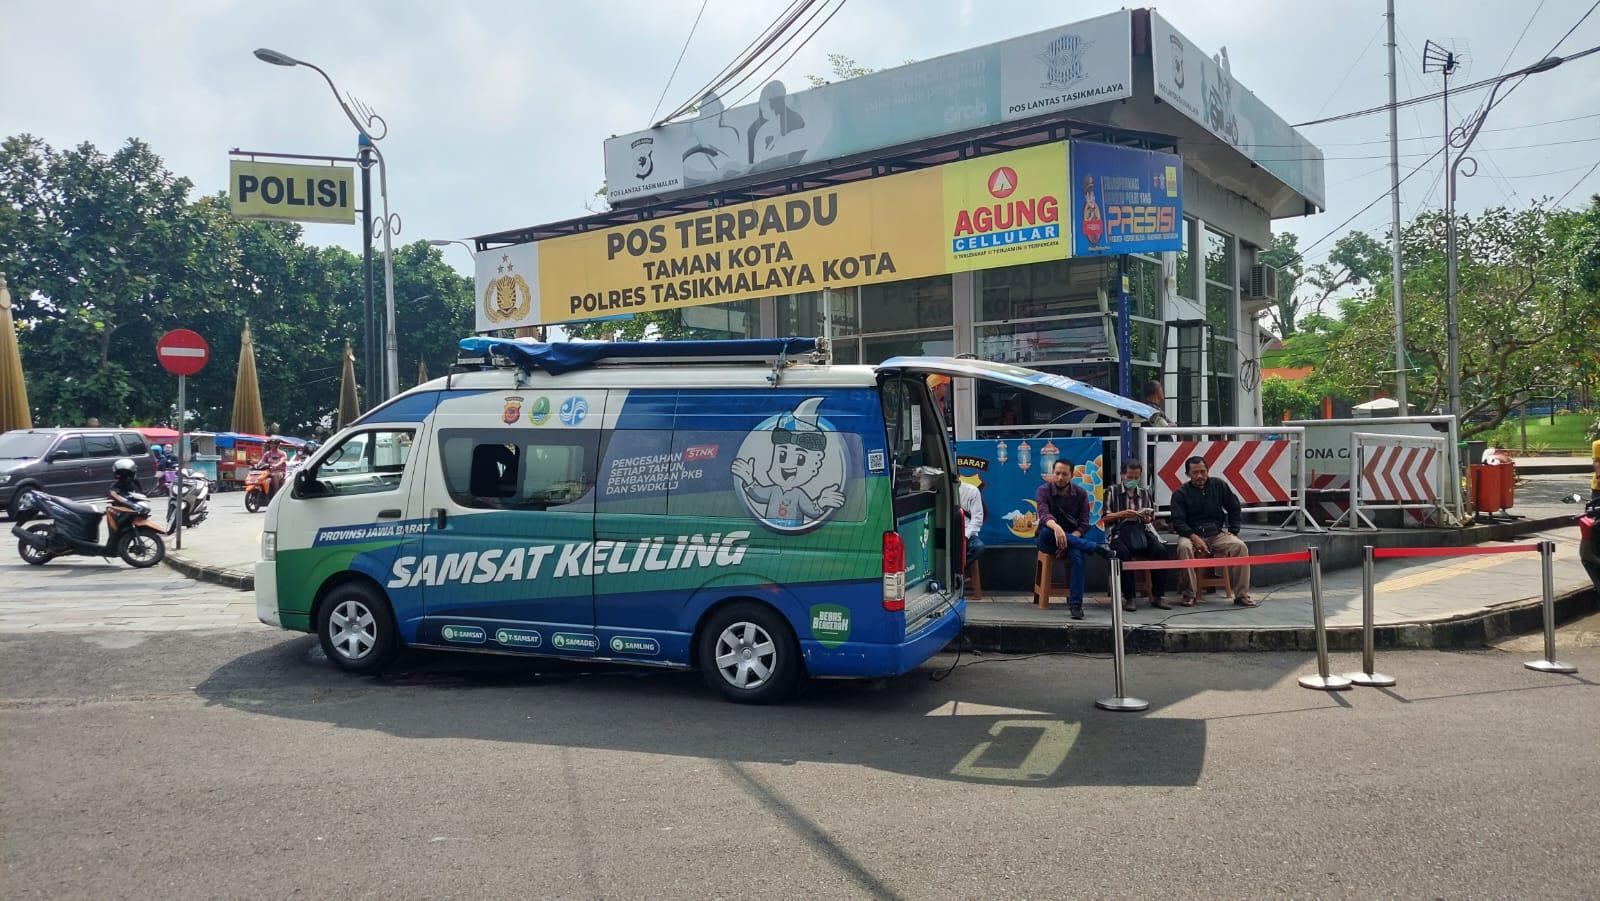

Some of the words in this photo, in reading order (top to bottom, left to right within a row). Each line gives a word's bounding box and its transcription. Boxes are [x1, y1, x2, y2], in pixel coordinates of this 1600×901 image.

[1009, 104, 1026, 114] POS
[1027, 95, 1060, 110] LANTAS
[1062, 82, 1124, 102] TASIKMALAYA
[239, 174, 348, 208] POLISI
[610, 189, 621, 197] POS
[621, 185, 641, 195] LANTAS
[642, 178, 678, 190] TASIKMALAYA
[607, 224, 667, 260] POS
[675, 192, 838, 249] TERPADU
[953, 196, 1059, 237] AGUNG
[955, 225, 1057, 252] CELLULAR
[643, 252, 721, 281] TAMAN
[728, 241, 793, 270] KOTA
[570, 286, 646, 314] POLRES
[651, 261, 815, 304] TASIKMALAYA
[822, 252, 897, 282] KOTA
[612, 452, 682, 468] PENGESAHAN
[687, 448, 715, 458] STNK
[1295, 447, 1334, 459] ONA
[610, 465, 647, 478] SETIAP
[647, 461, 687, 474] TAHUN,
[957, 458, 985, 468] BARAT
[608, 472, 679, 486] PEMBAYARAN
[682, 469, 703, 481] PKB
[605, 486, 629, 496] DAN
[630, 482, 679, 493] SWDKLLJ
[319, 529, 366, 542] PROVINSI
[366, 526, 395, 538] JAWA
[396, 523, 431, 535] BARAT
[388, 545, 556, 588] SAMSAT
[552, 530, 751, 578] KELILING
[453, 630, 483, 639] E-SAMSAT
[507, 634, 539, 643] T-SAMSAT
[565, 638, 597, 648] SAMADES
[625, 642, 655, 651] SAMLING
